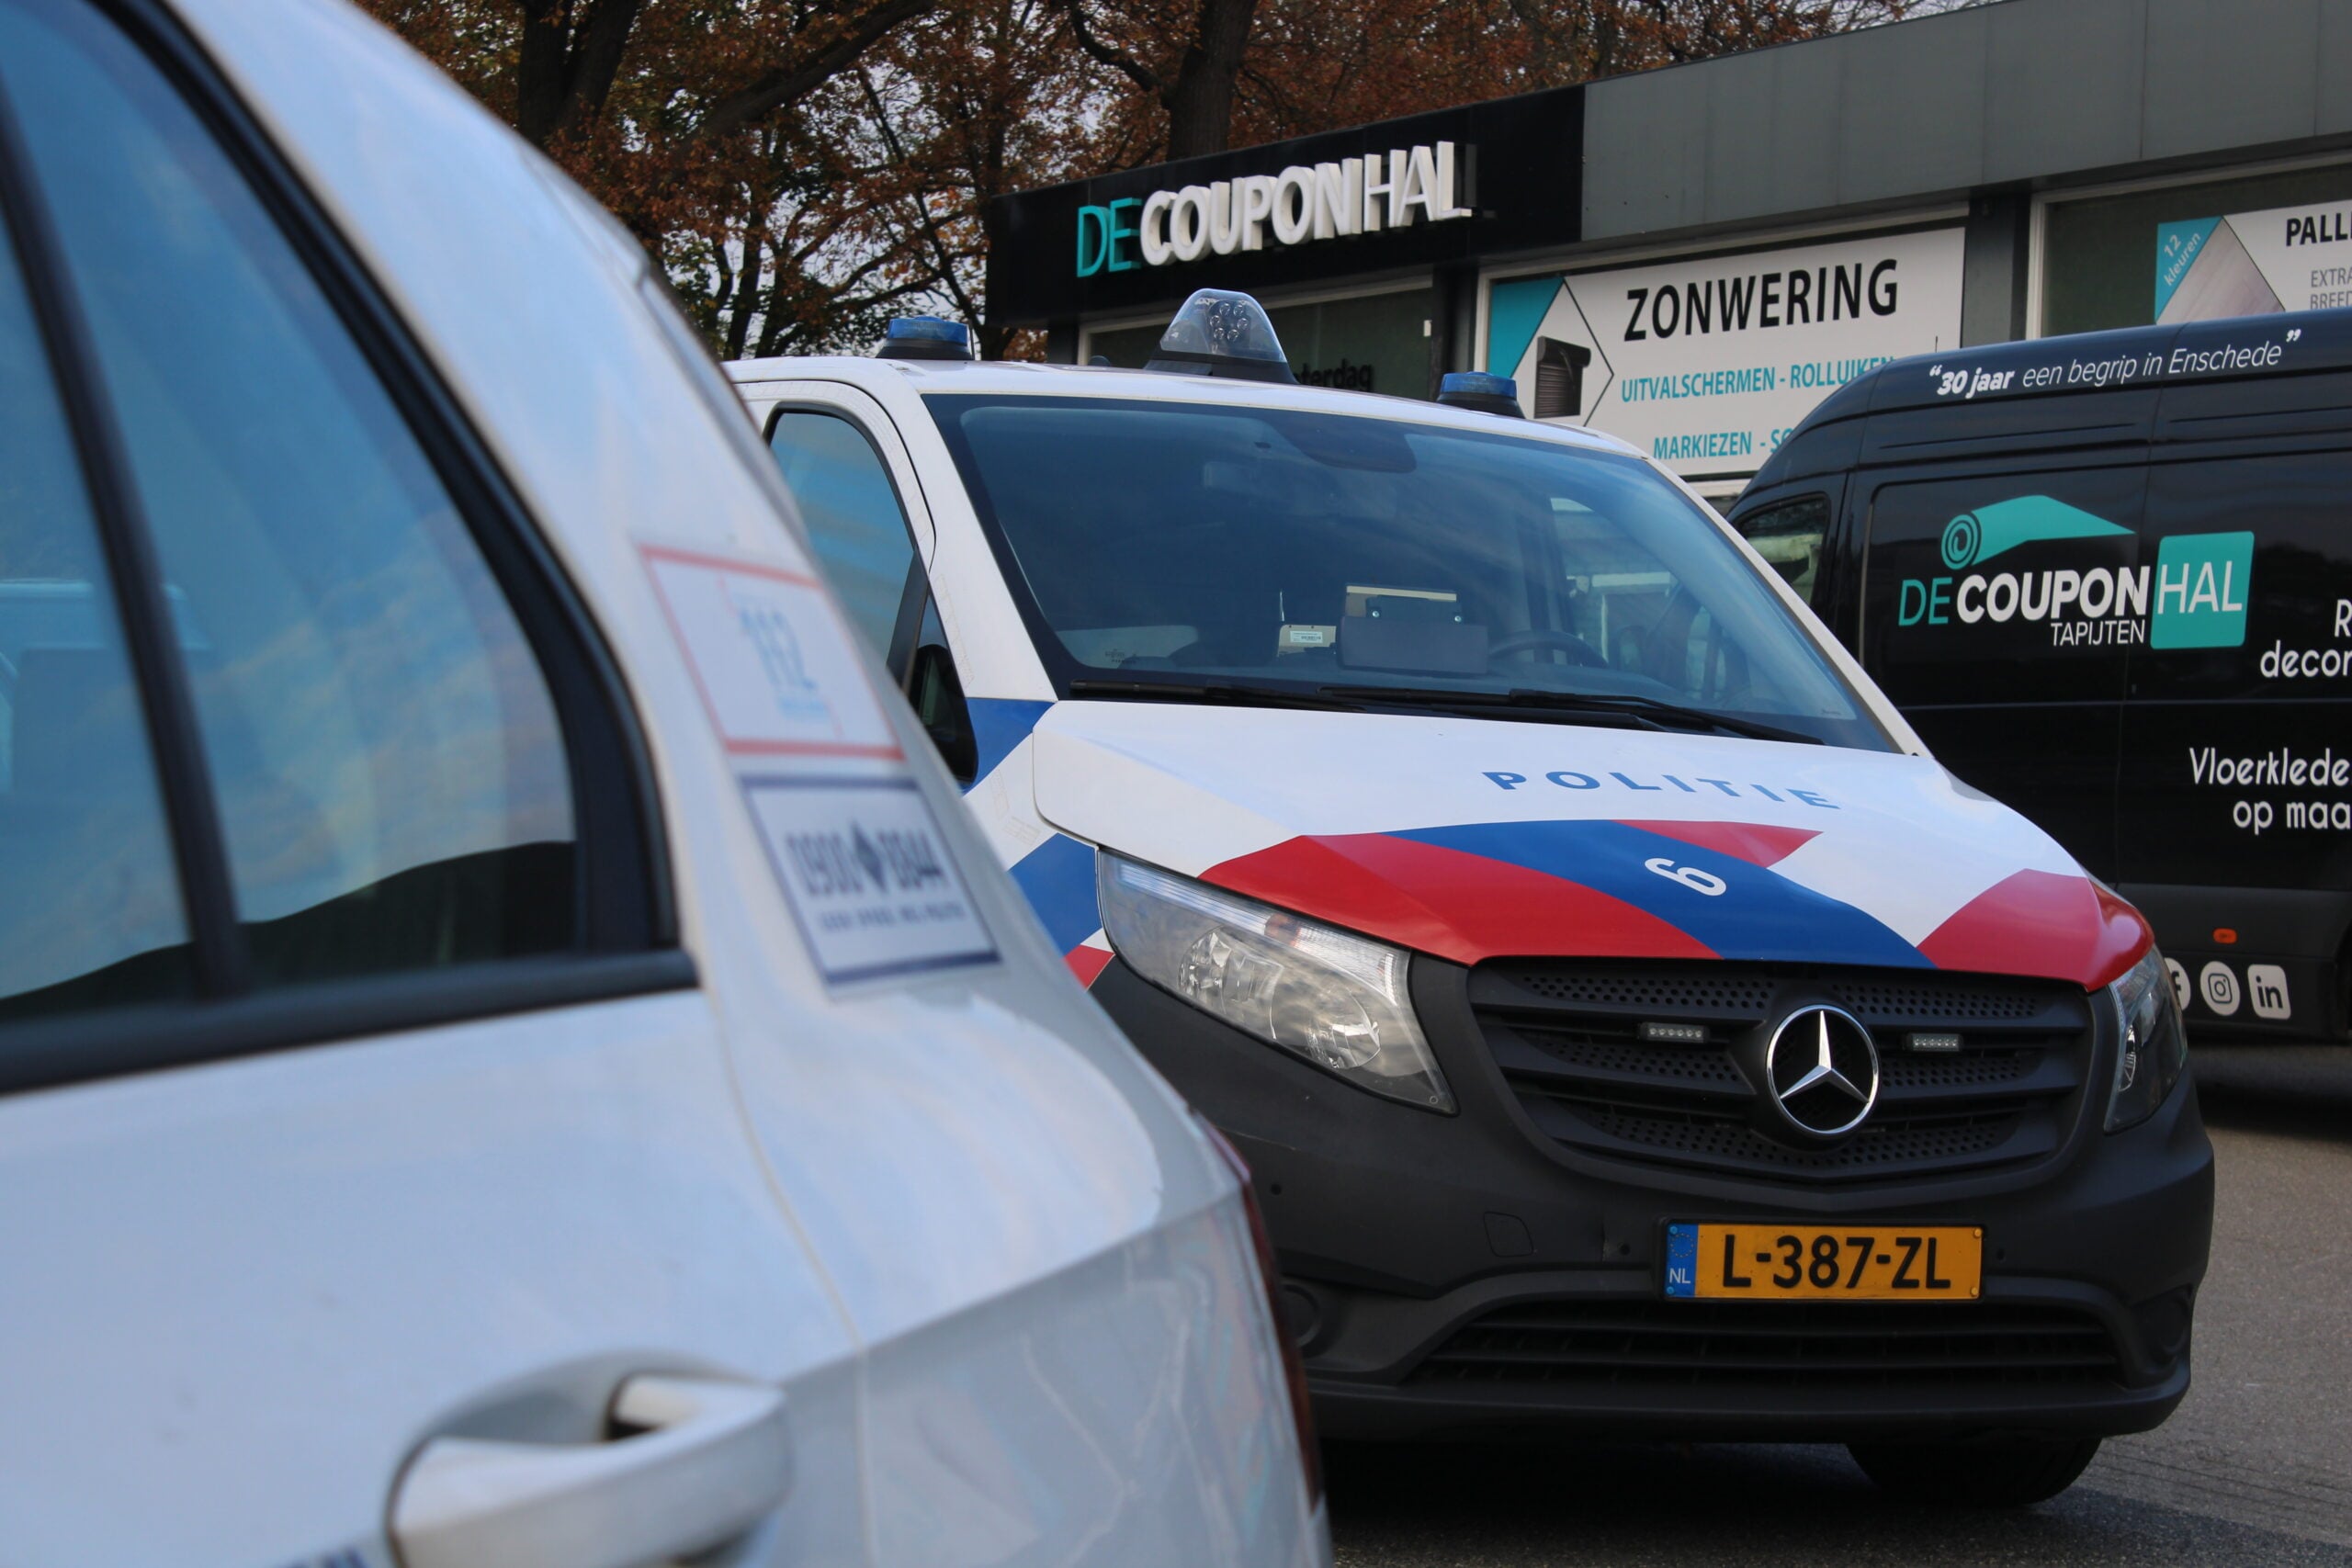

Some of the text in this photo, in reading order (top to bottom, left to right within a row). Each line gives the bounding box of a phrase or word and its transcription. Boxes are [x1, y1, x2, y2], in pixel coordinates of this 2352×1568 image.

[2164, 234, 2182, 258] 12
[2286, 211, 2352, 246] PALL
[2164, 232, 2201, 288] kleuren
[1623, 258, 1898, 343] ZONWERING
[1622, 367, 1776, 403] UITVALSCHERMEN
[1790, 356, 1895, 389] ROLLUIK
[1965, 367, 2016, 400] jaar
[2022, 366, 2064, 389] een
[2067, 355, 2138, 388] begrip
[2143, 352, 2163, 378] in
[1654, 430, 1752, 460] MARKIEZEN
[2050, 619, 2145, 647] TAPIJTEN
[2188, 747, 2351, 786] Vloerklede
[1481, 771, 1842, 810] POLITIE
[2233, 800, 2352, 836] op maa
[1644, 858, 1727, 897] 6
[2256, 975, 2284, 1010] in
[1668, 1233, 1951, 1290] NL L-387-ZL
